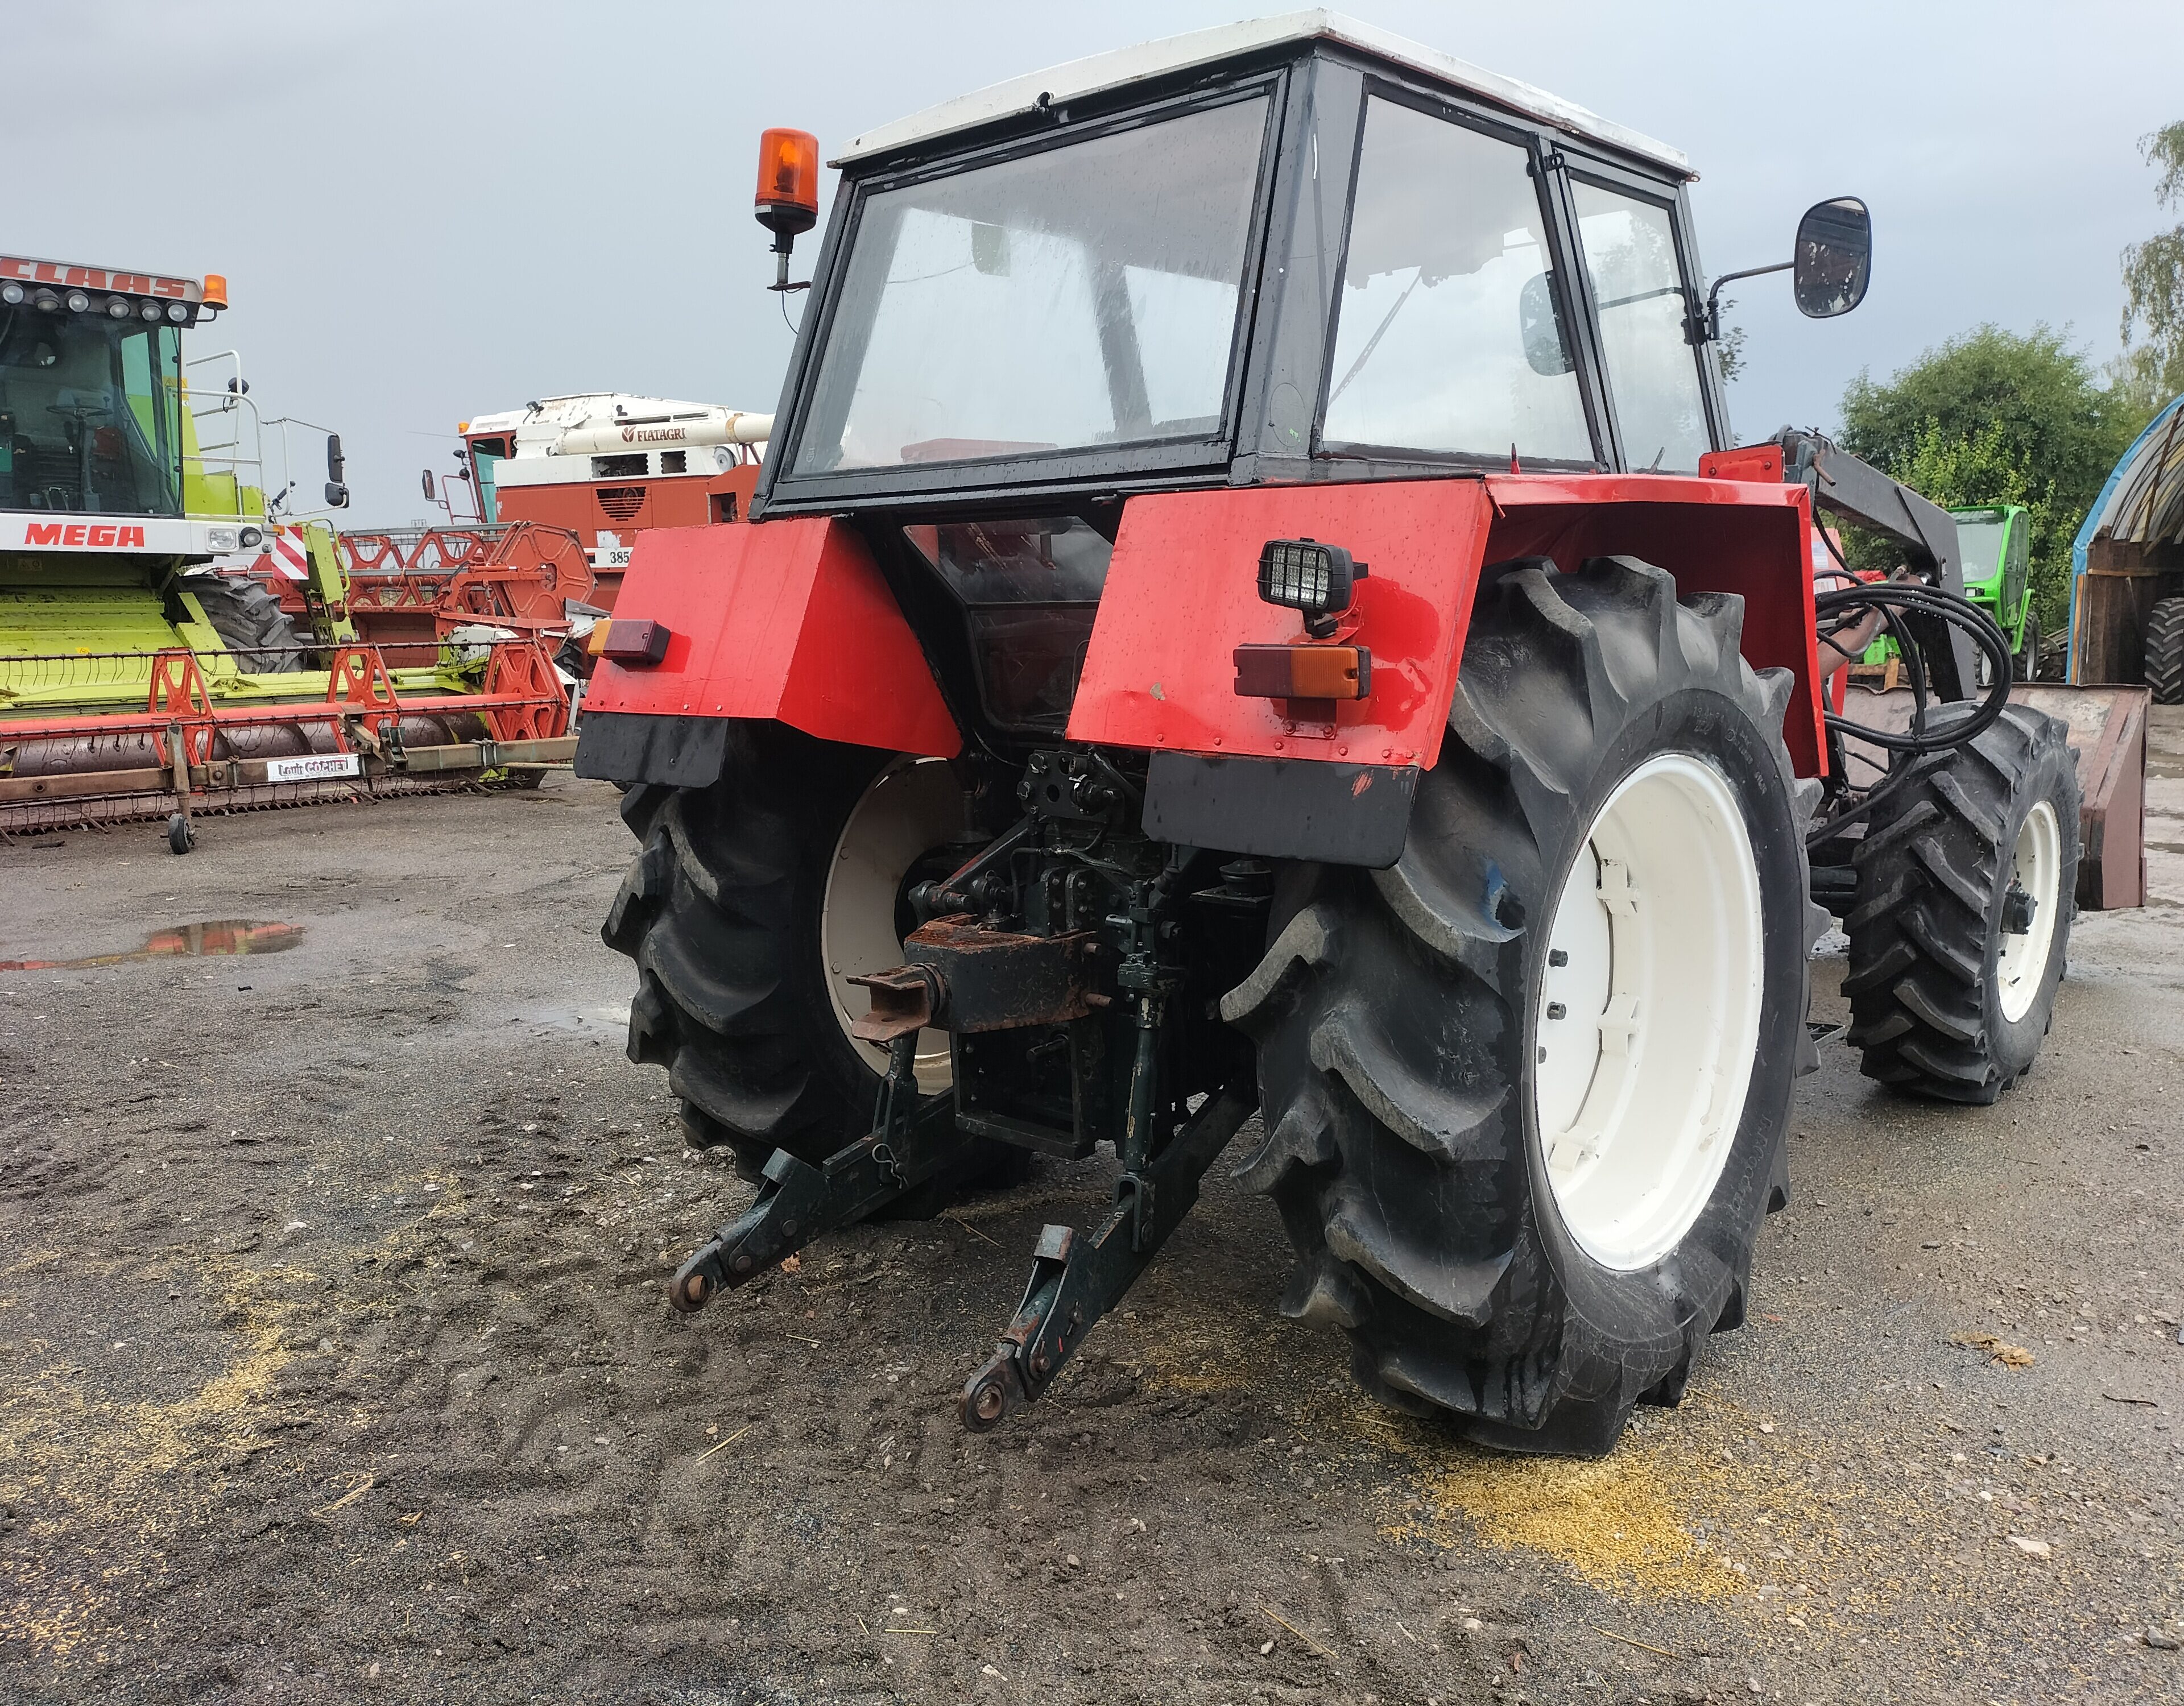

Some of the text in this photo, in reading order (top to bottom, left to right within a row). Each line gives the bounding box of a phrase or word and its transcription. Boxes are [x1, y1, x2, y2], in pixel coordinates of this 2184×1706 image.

[0, 258, 186, 298] CLAAS
[638, 428, 686, 442] FIATAGRI
[24, 523, 144, 547] MEGA
[610, 551, 631, 564] 385
[305, 759, 349, 773] COCHET
